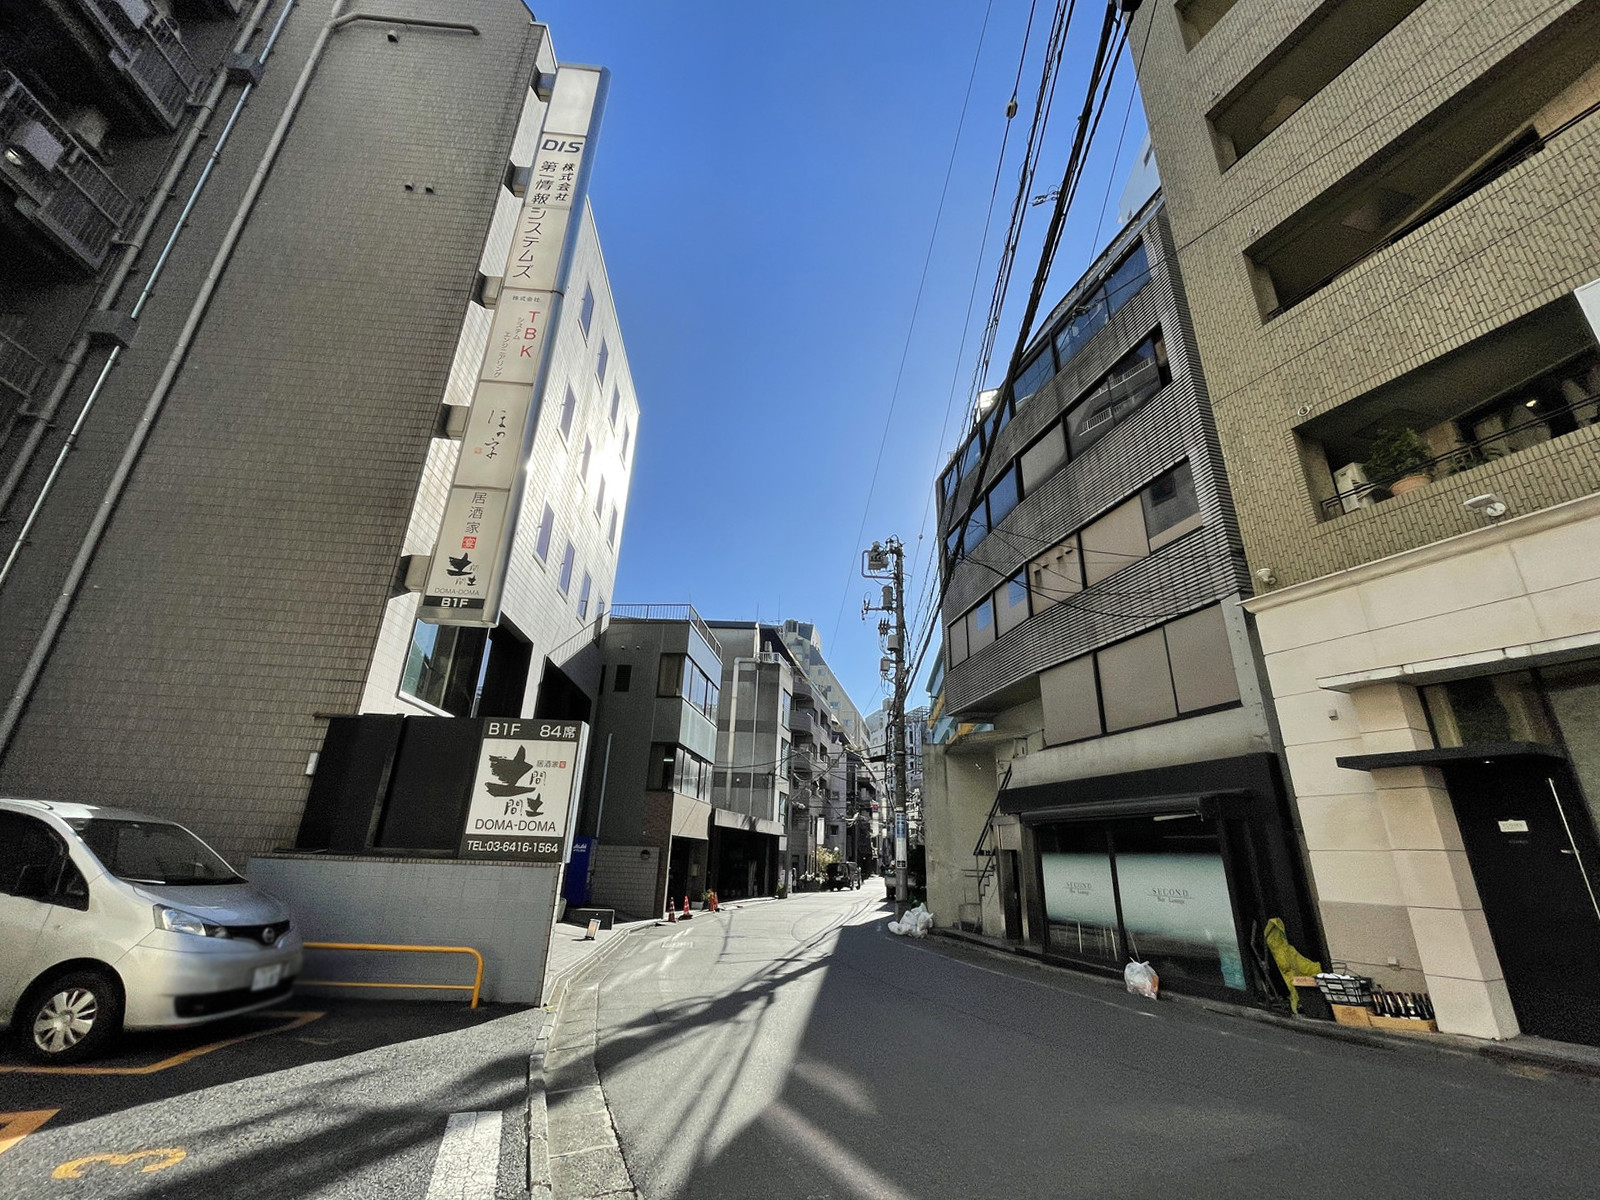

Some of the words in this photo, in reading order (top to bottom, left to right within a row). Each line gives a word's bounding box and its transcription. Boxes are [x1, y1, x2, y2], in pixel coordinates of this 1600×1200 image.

[542, 139, 583, 153] DIS
[554, 162, 576, 202] 株式会社
[512, 160, 559, 279] 第一情報システムズ
[519, 311, 541, 358] TBK
[465, 492, 487, 534] 居酒家
[434, 587, 480, 597] DOMA-DOMA
[441, 597, 469, 608] B1F
[488, 723, 521, 736] B1F
[539, 724, 577, 739] 84席
[474, 818, 556, 832] DOMA-DOMA
[467, 840, 558, 853] TEL:03-6416-1564
[1151, 887, 1189, 897] SECOND
